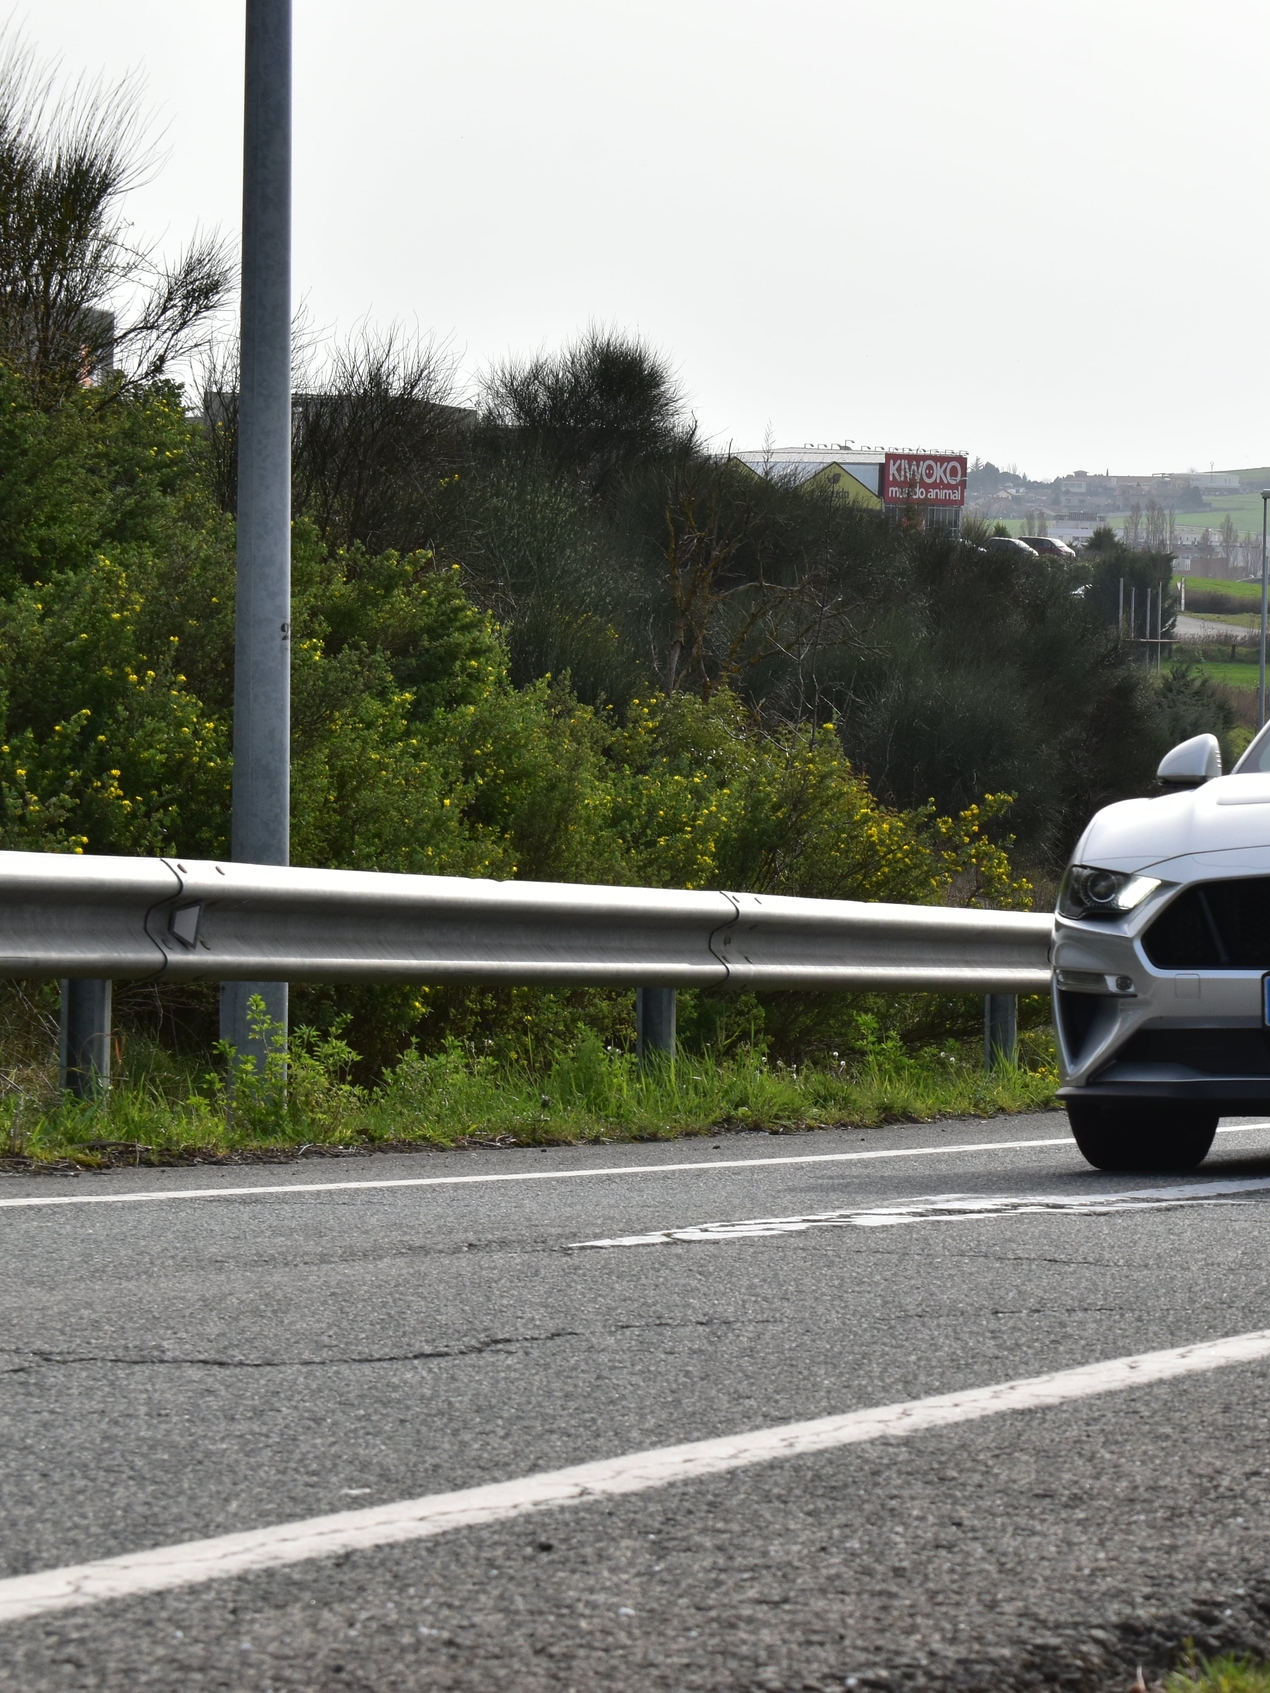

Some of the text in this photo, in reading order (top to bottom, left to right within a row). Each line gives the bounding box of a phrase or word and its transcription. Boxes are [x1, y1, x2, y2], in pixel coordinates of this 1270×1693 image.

[889, 459, 962, 485] KIWOKO
[888, 483, 961, 501] mudo animal
